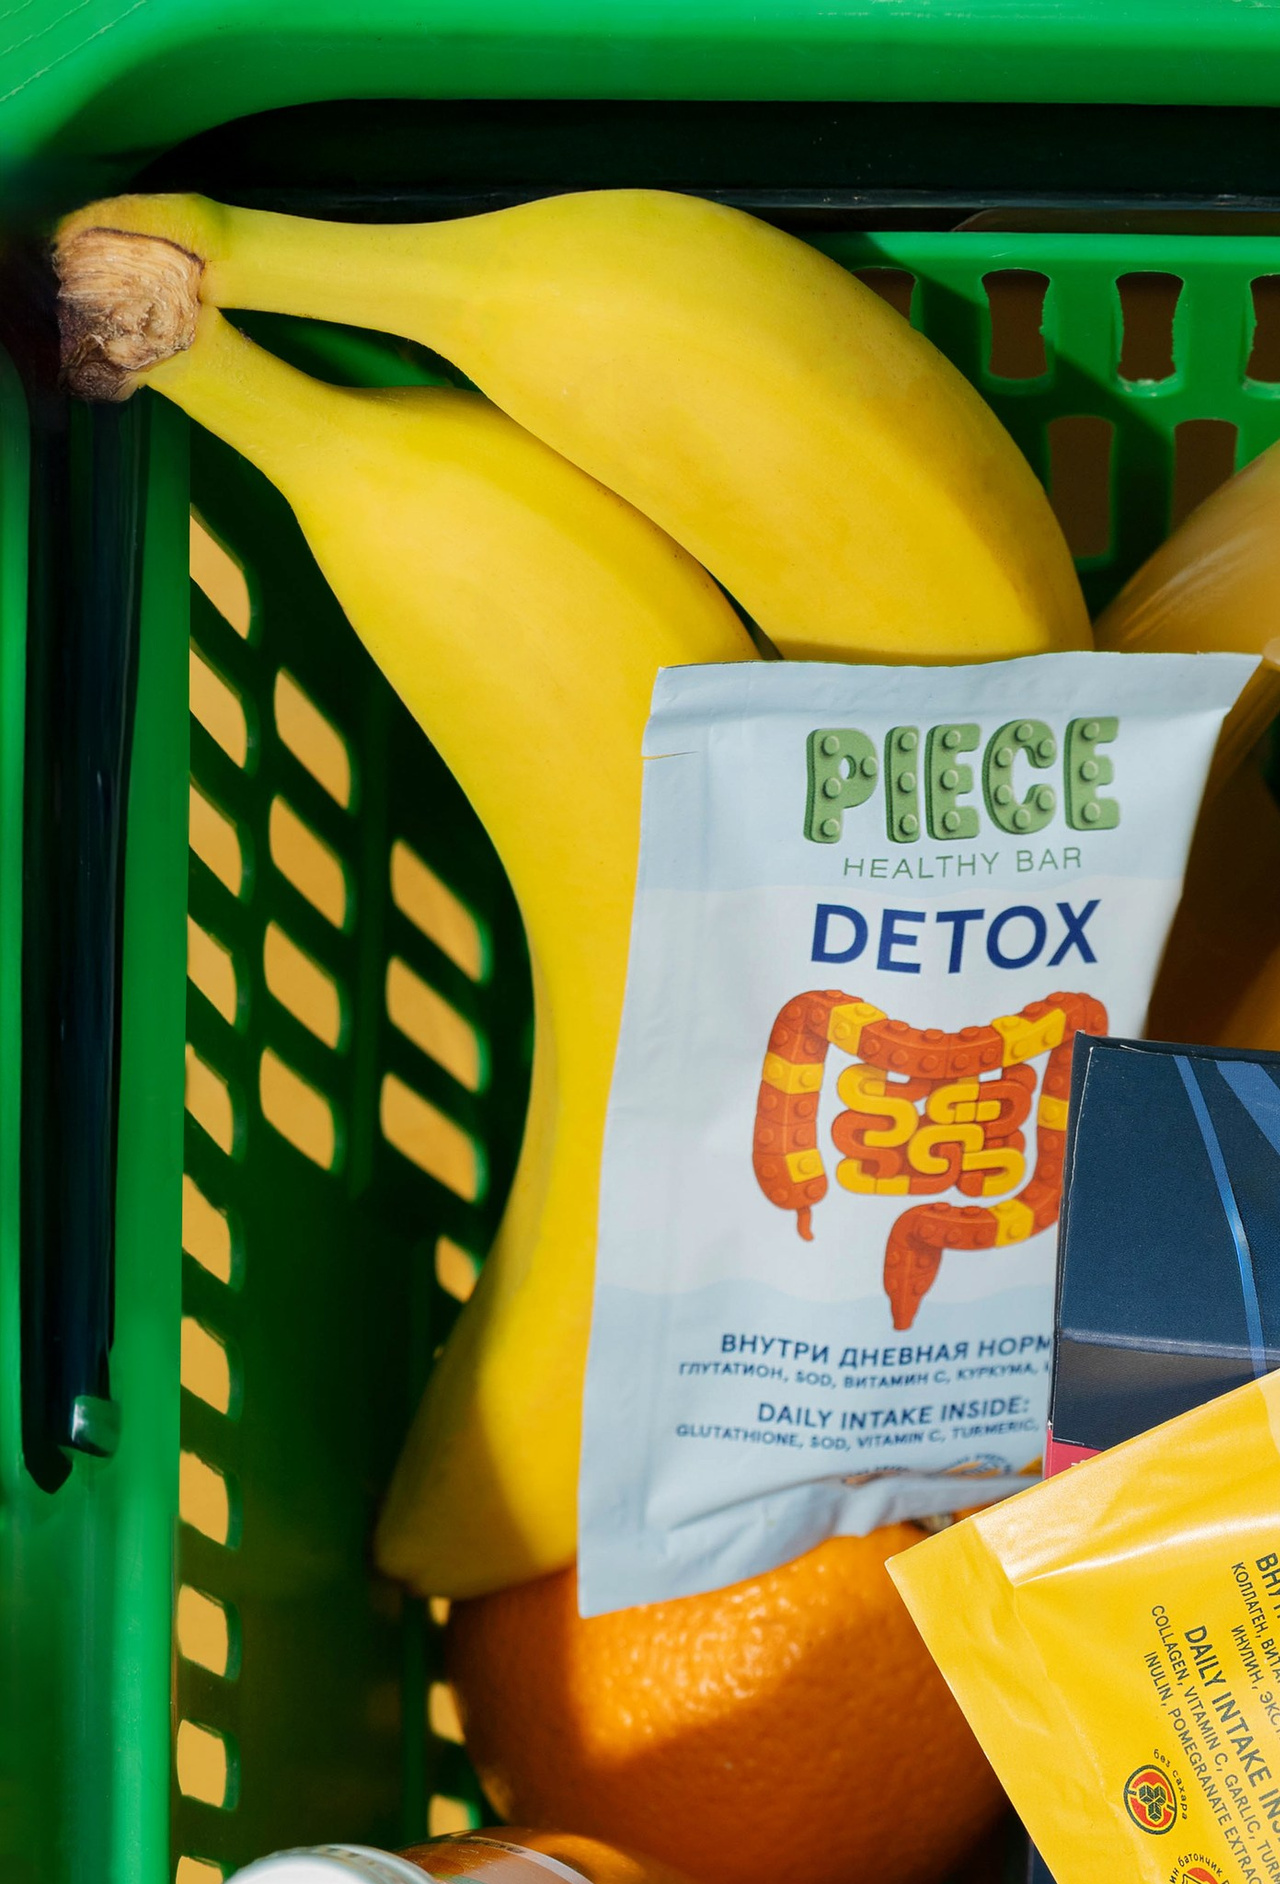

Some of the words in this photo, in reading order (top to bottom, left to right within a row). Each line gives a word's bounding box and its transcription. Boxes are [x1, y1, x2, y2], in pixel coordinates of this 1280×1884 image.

[803, 717, 1123, 845] PIECE
[843, 851, 999, 879] HEALTHY
[1016, 846, 1081, 873] BAR
[811, 899, 1100, 974] DETOX
[721, 1334, 829, 1364] ВНУТРИ
[838, 1342, 969, 1369] ДНЕВНАЯ
[845, 1373, 929, 1387] ВИТАМИН
[676, 1424, 803, 1448] GLUTATHIONE,
[810, 1436, 851, 1451] SOD,
[857, 1432, 924, 1448] VITAMIN
[952, 1418, 1039, 1440] TURMERIC,
[758, 1403, 832, 1428] DAILY
[841, 1406, 933, 1430] INTAKE
[941, 1397, 1030, 1421] INSIDE:
[1231, 1562, 1269, 1638] КОЛЛАГЕН,
[1231, 1624, 1264, 1689] ИНУЛИН,
[1144, 1651, 1174, 1706] INULIN,
[1168, 1707, 1232, 1826] POMEGRANATE
[1151, 1605, 1190, 1686] COLLAGEN,
[1184, 1686, 1221, 1751] VITAMIN
[1214, 1752, 1228, 1772] C,
[1224, 1774, 1261, 1839] GARLIC,
[1184, 1625, 1226, 1687] DAILY
[1212, 1691, 1272, 1788] INTAKE
[1153, 1748, 1171, 1768] без
[1172, 1770, 1188, 1820] сахара
[1177, 1852, 1224, 1878] батончик
